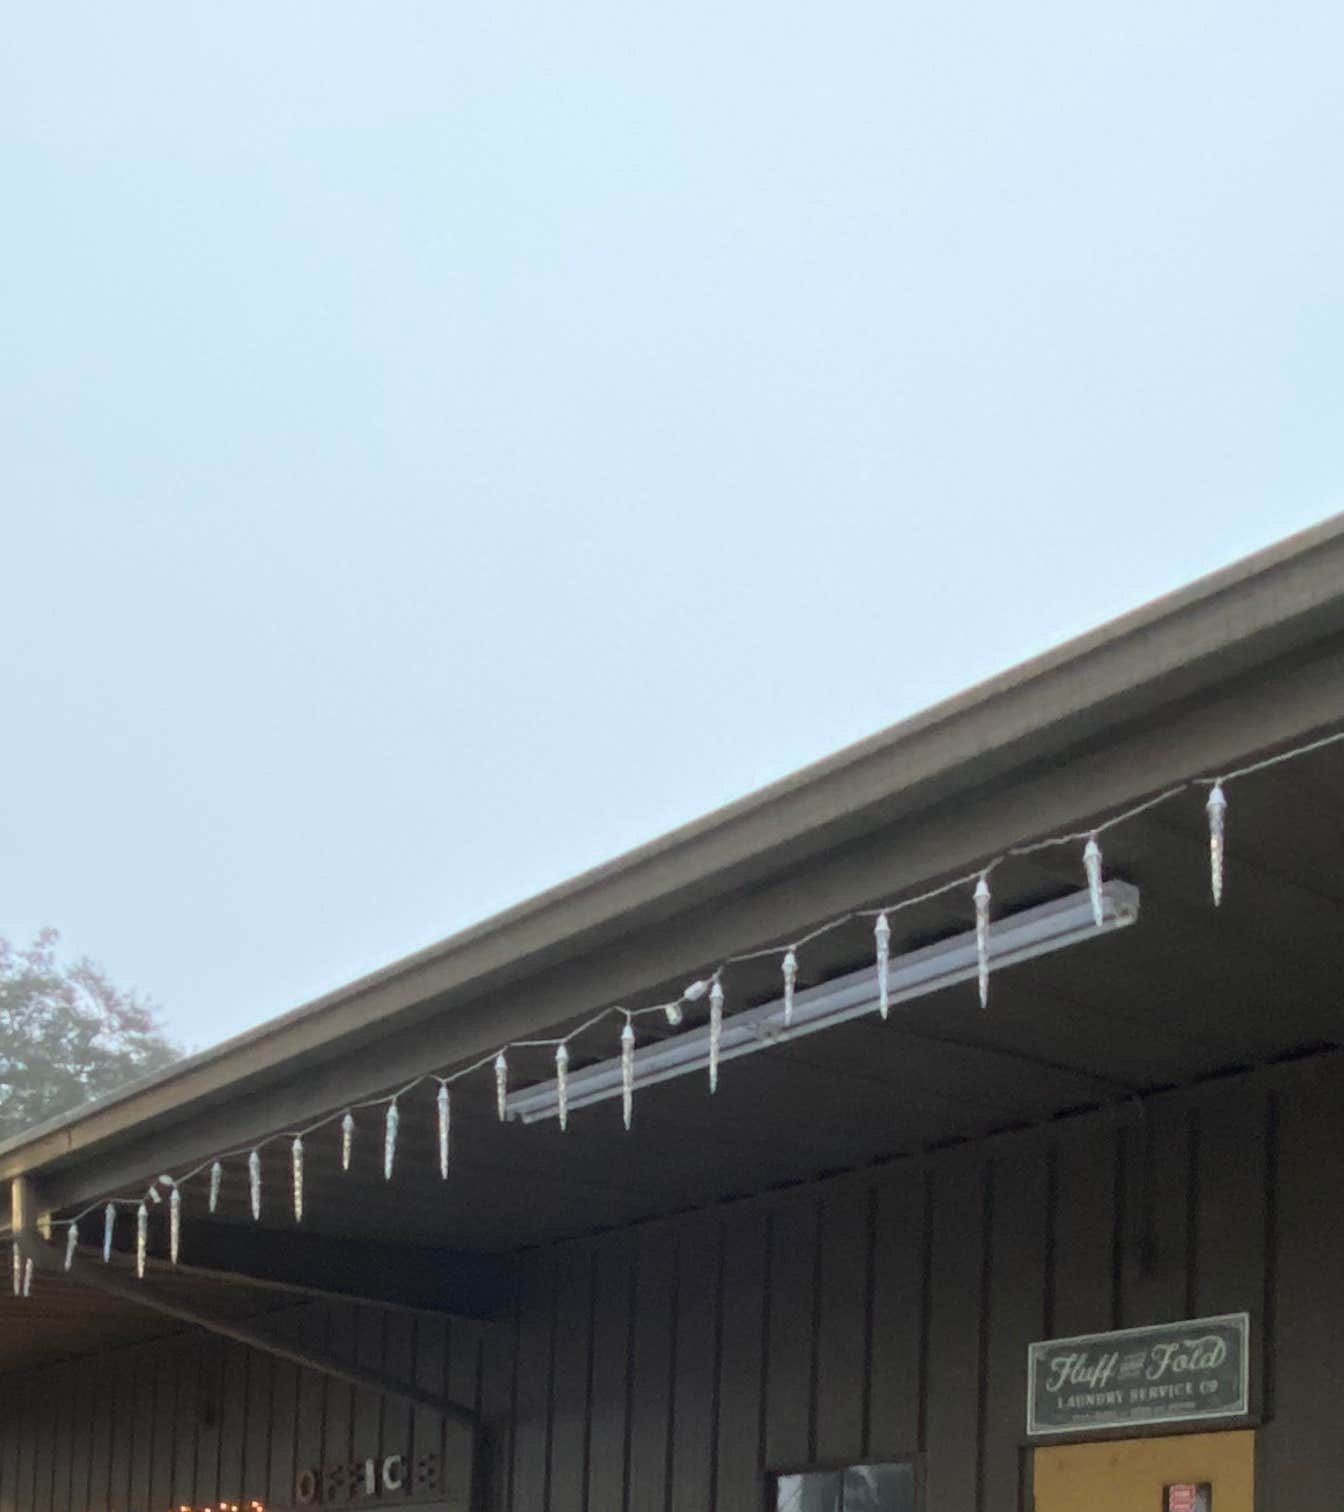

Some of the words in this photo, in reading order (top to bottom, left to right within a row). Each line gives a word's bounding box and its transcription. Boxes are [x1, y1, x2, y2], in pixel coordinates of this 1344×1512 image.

[1046, 1351, 1119, 1392] Fluff
[1146, 1335, 1226, 1380] Fold
[1057, 1389, 1123, 1409] LAUNDRY
[1130, 1381, 1194, 1402] SERVICE
